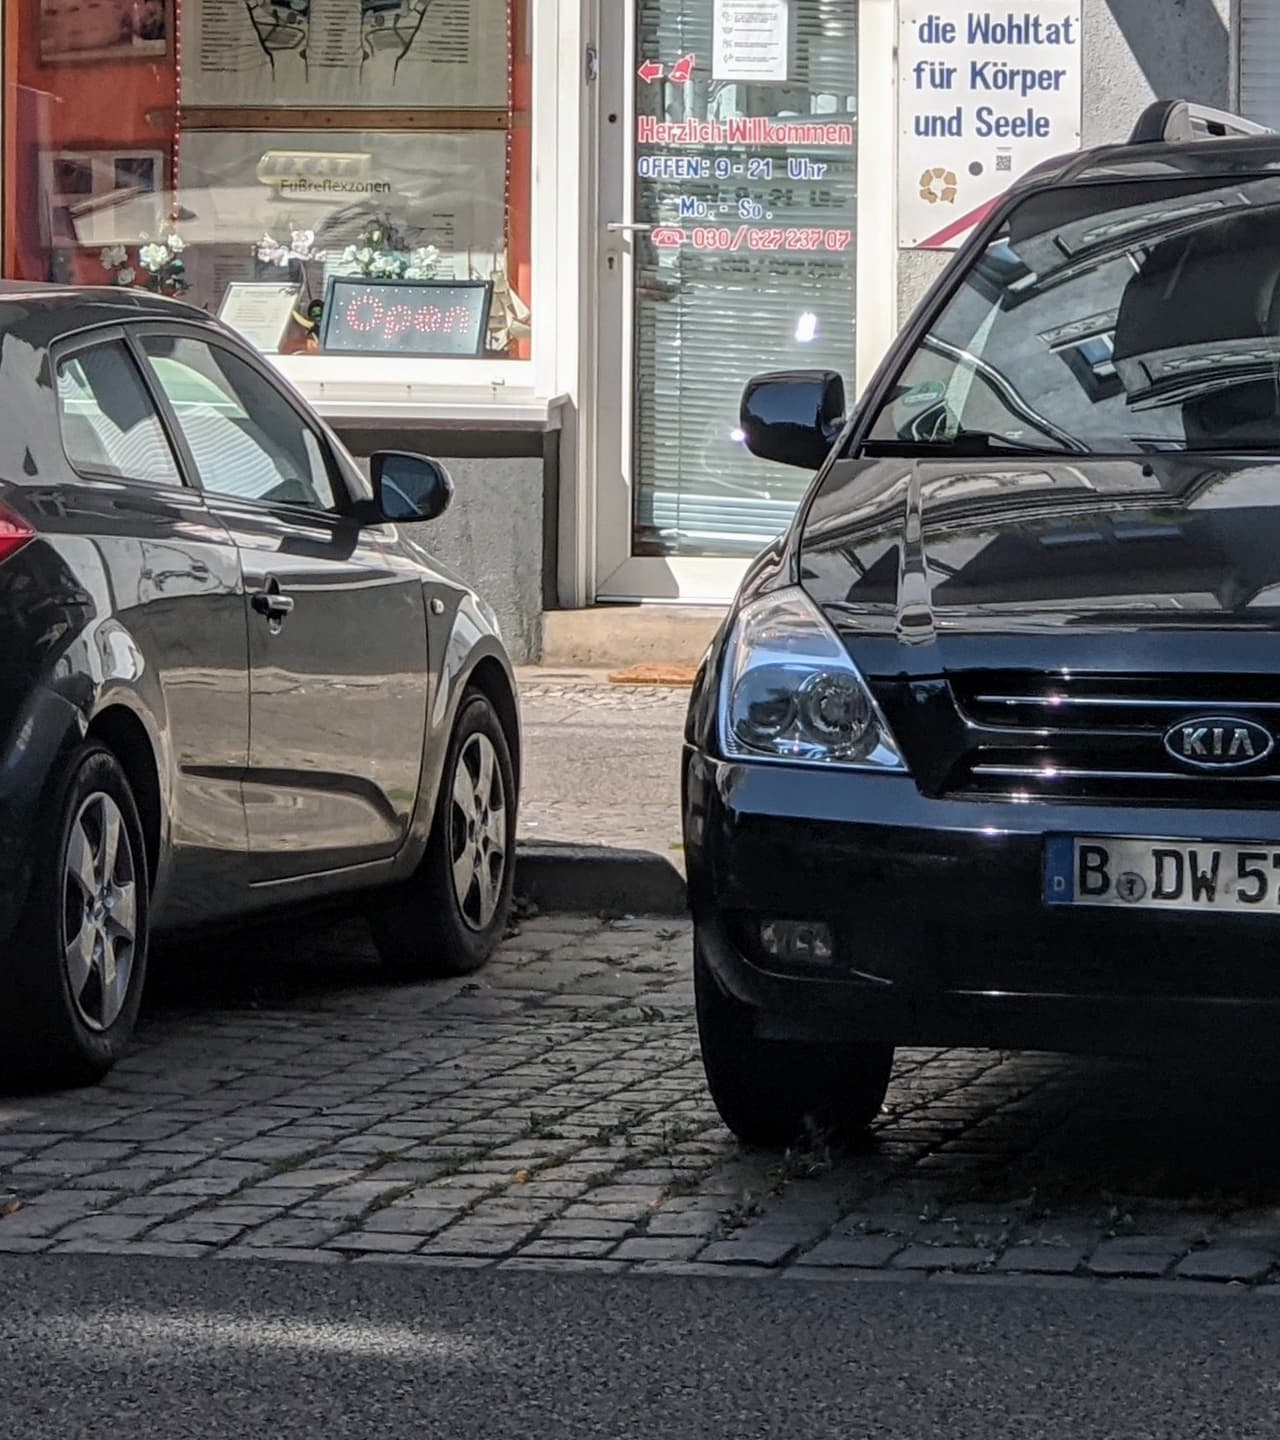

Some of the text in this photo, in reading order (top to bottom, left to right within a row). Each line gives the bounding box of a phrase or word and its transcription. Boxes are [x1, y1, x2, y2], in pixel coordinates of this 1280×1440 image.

[918, 12, 1076, 45] die Wohltat
[913, 60, 1066, 97] für Körper
[637, 116, 853, 144] Herzlich Willkommen
[914, 106, 1051, 137] und Seele
[637, 156, 710, 178] OFFEN:
[787, 158, 828, 180] Uhr
[279, 178, 391, 193] Fußreflexzonen
[347, 295, 470, 340] Open
[1181, 727, 1255, 756] KIA
[1079, 845, 1110, 896] B
[1151, 848, 1219, 903] DW
